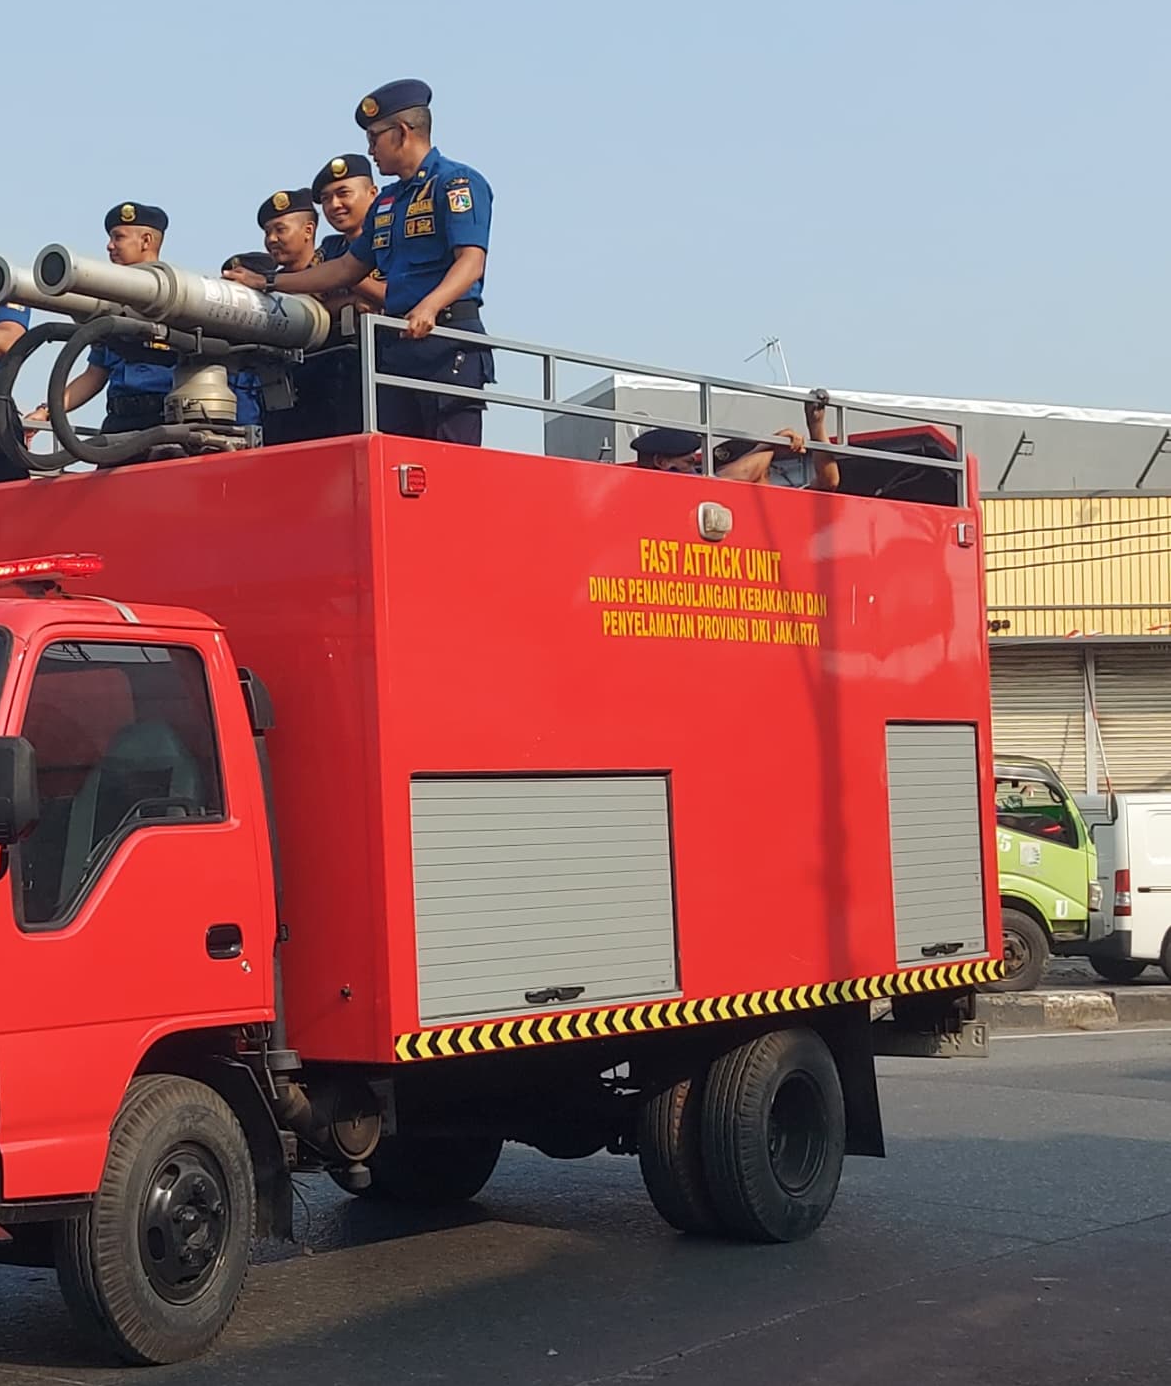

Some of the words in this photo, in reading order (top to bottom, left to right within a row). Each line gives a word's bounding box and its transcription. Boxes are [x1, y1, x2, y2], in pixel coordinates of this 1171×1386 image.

[639, 538, 679, 574] FAST
[683, 543, 743, 580] ATTACK
[745, 548, 781, 583] UNIT
[589, 576, 626, 603] DINAS
[629, 579, 737, 610] PENANGGULANGAN
[740, 586, 805, 615] KEBAKARAN
[807, 593, 827, 618] DAN
[603, 611, 695, 639] PENYELAMATAN
[697, 615, 749, 642] PROVINSI
[752, 619, 771, 643] DKI
[773, 621, 820, 646] JAKARTA
